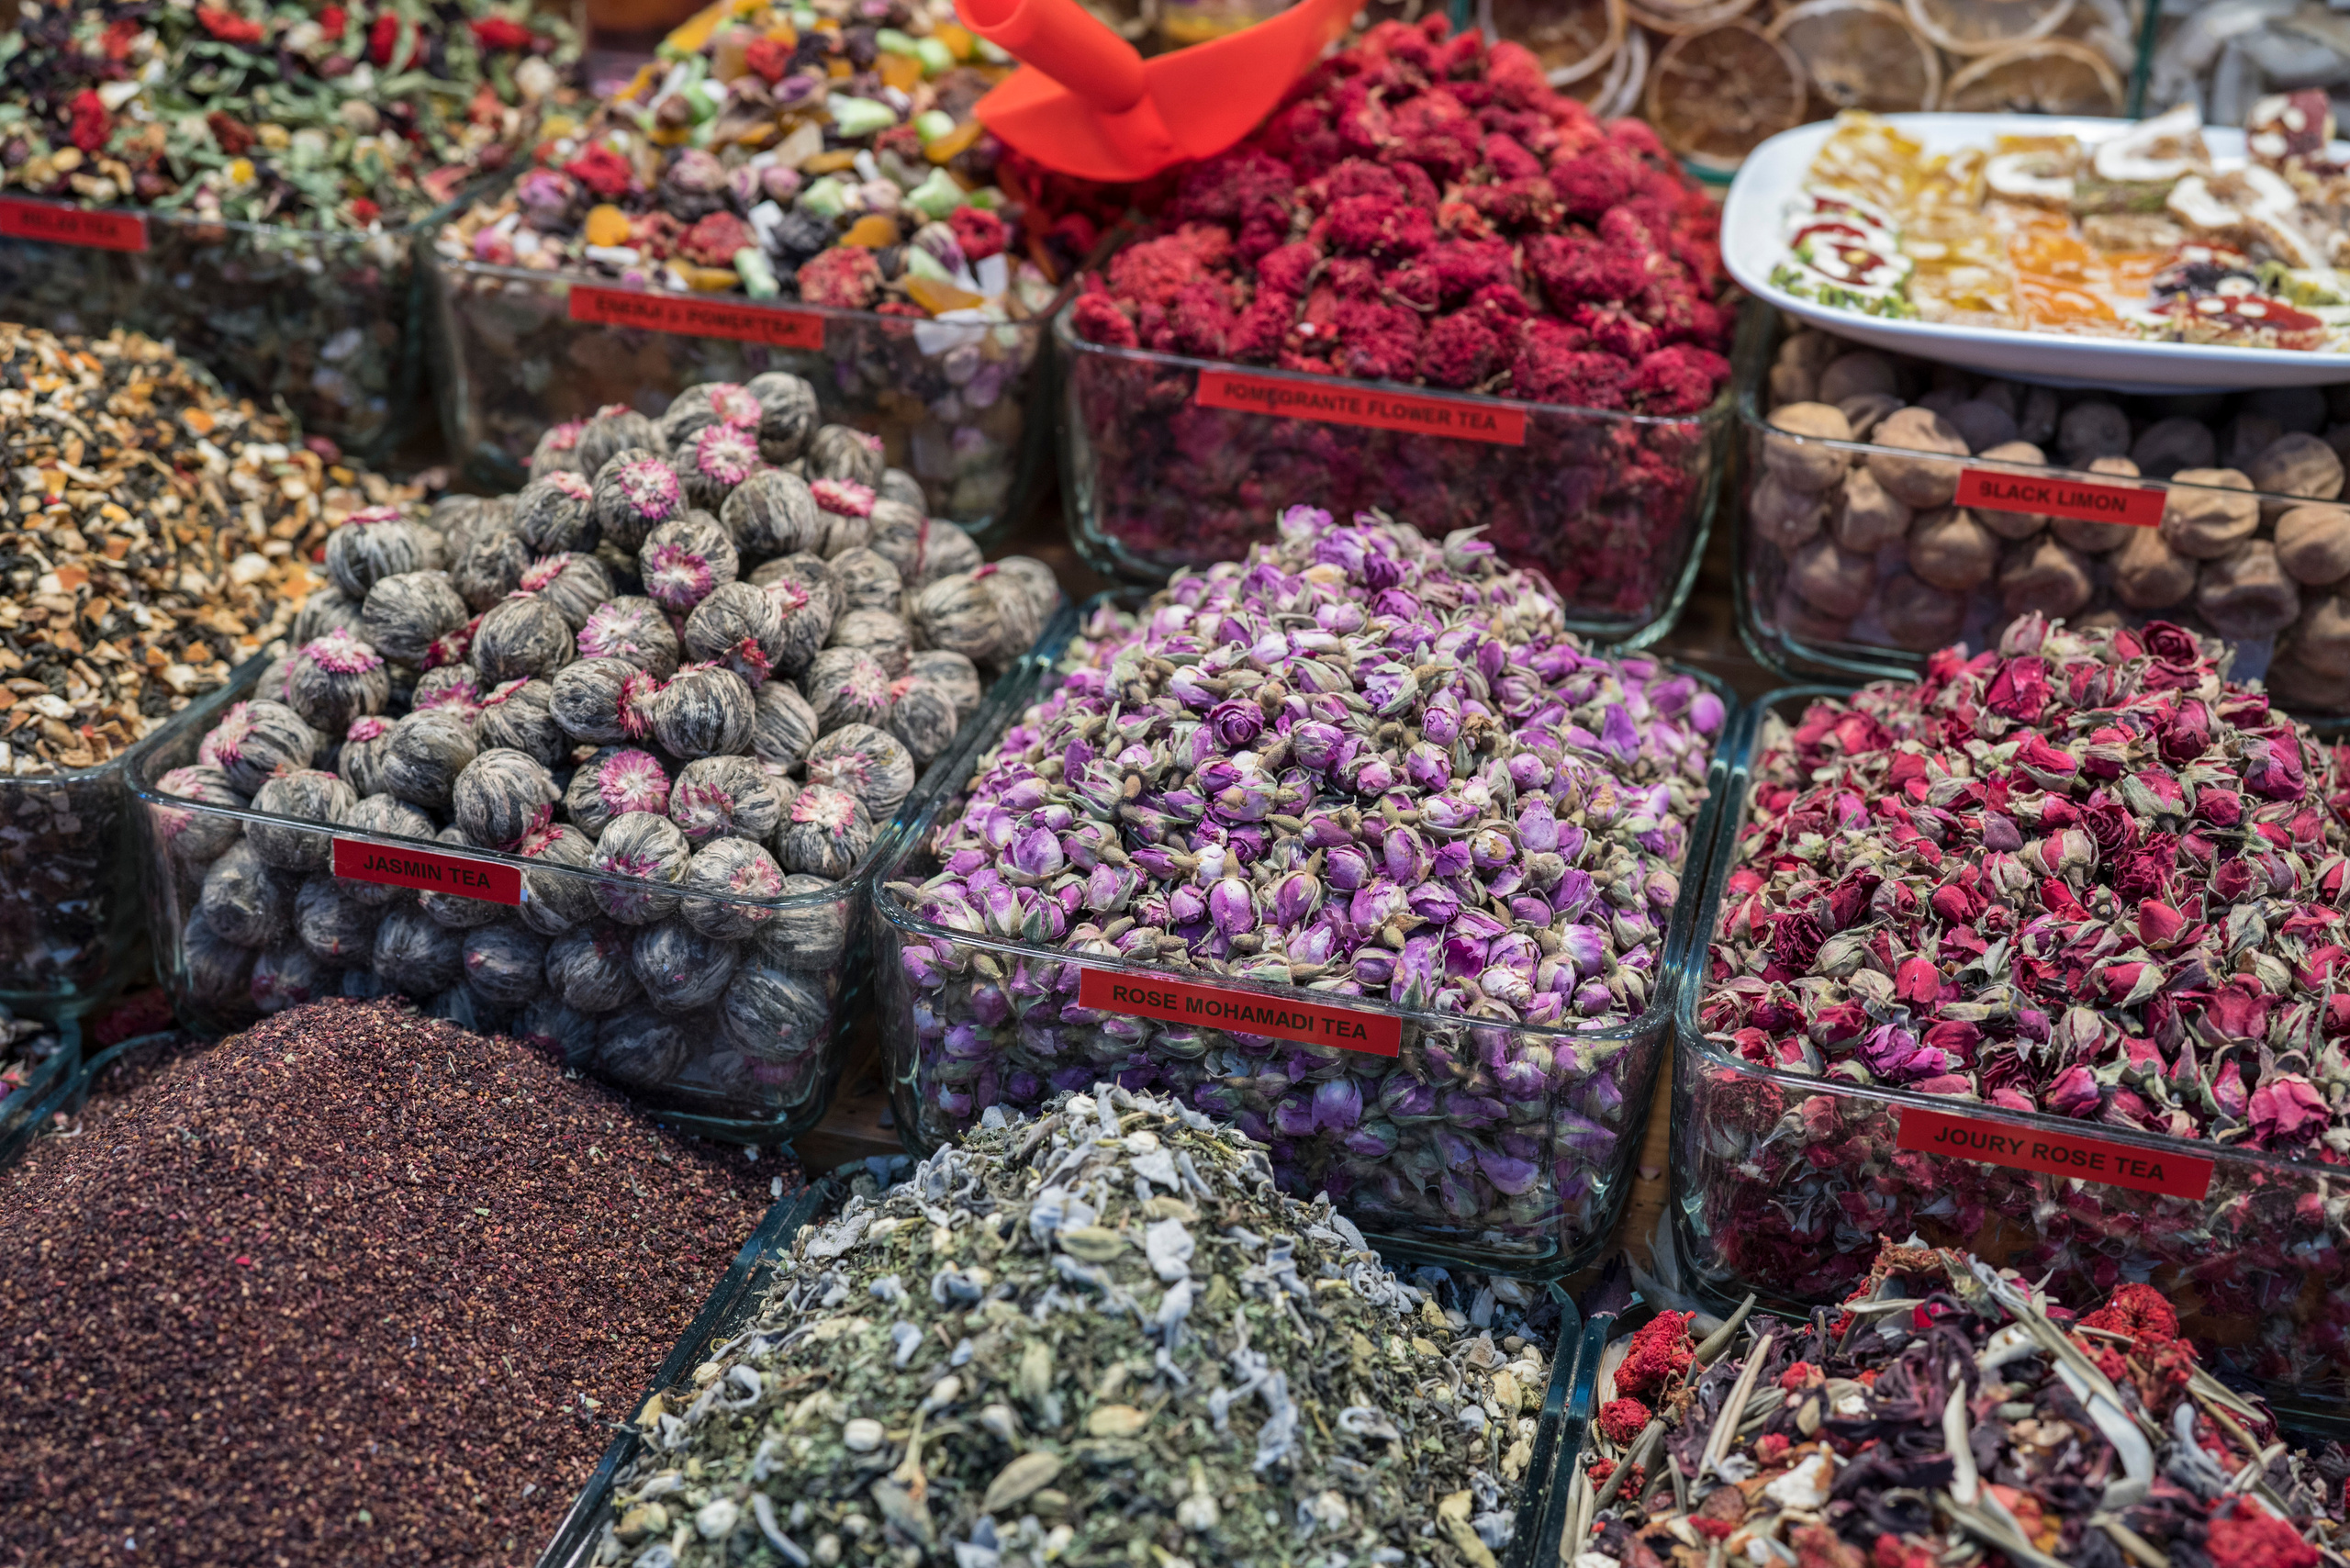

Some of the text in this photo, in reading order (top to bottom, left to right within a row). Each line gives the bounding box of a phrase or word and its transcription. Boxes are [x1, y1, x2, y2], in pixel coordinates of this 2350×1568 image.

[687, 308, 755, 330] POWER
[759, 315, 799, 334] TEA
[1224, 382, 1498, 431] POMEGRANTE FLOWER TEA
[1979, 480, 2127, 513] BLACK LIMON
[364, 855, 491, 889] JASMIN TEA
[1113, 984, 1368, 1040] ROSE MOHAMADI TEA
[1934, 1126, 2165, 1182] JOURY ROSE TEA
